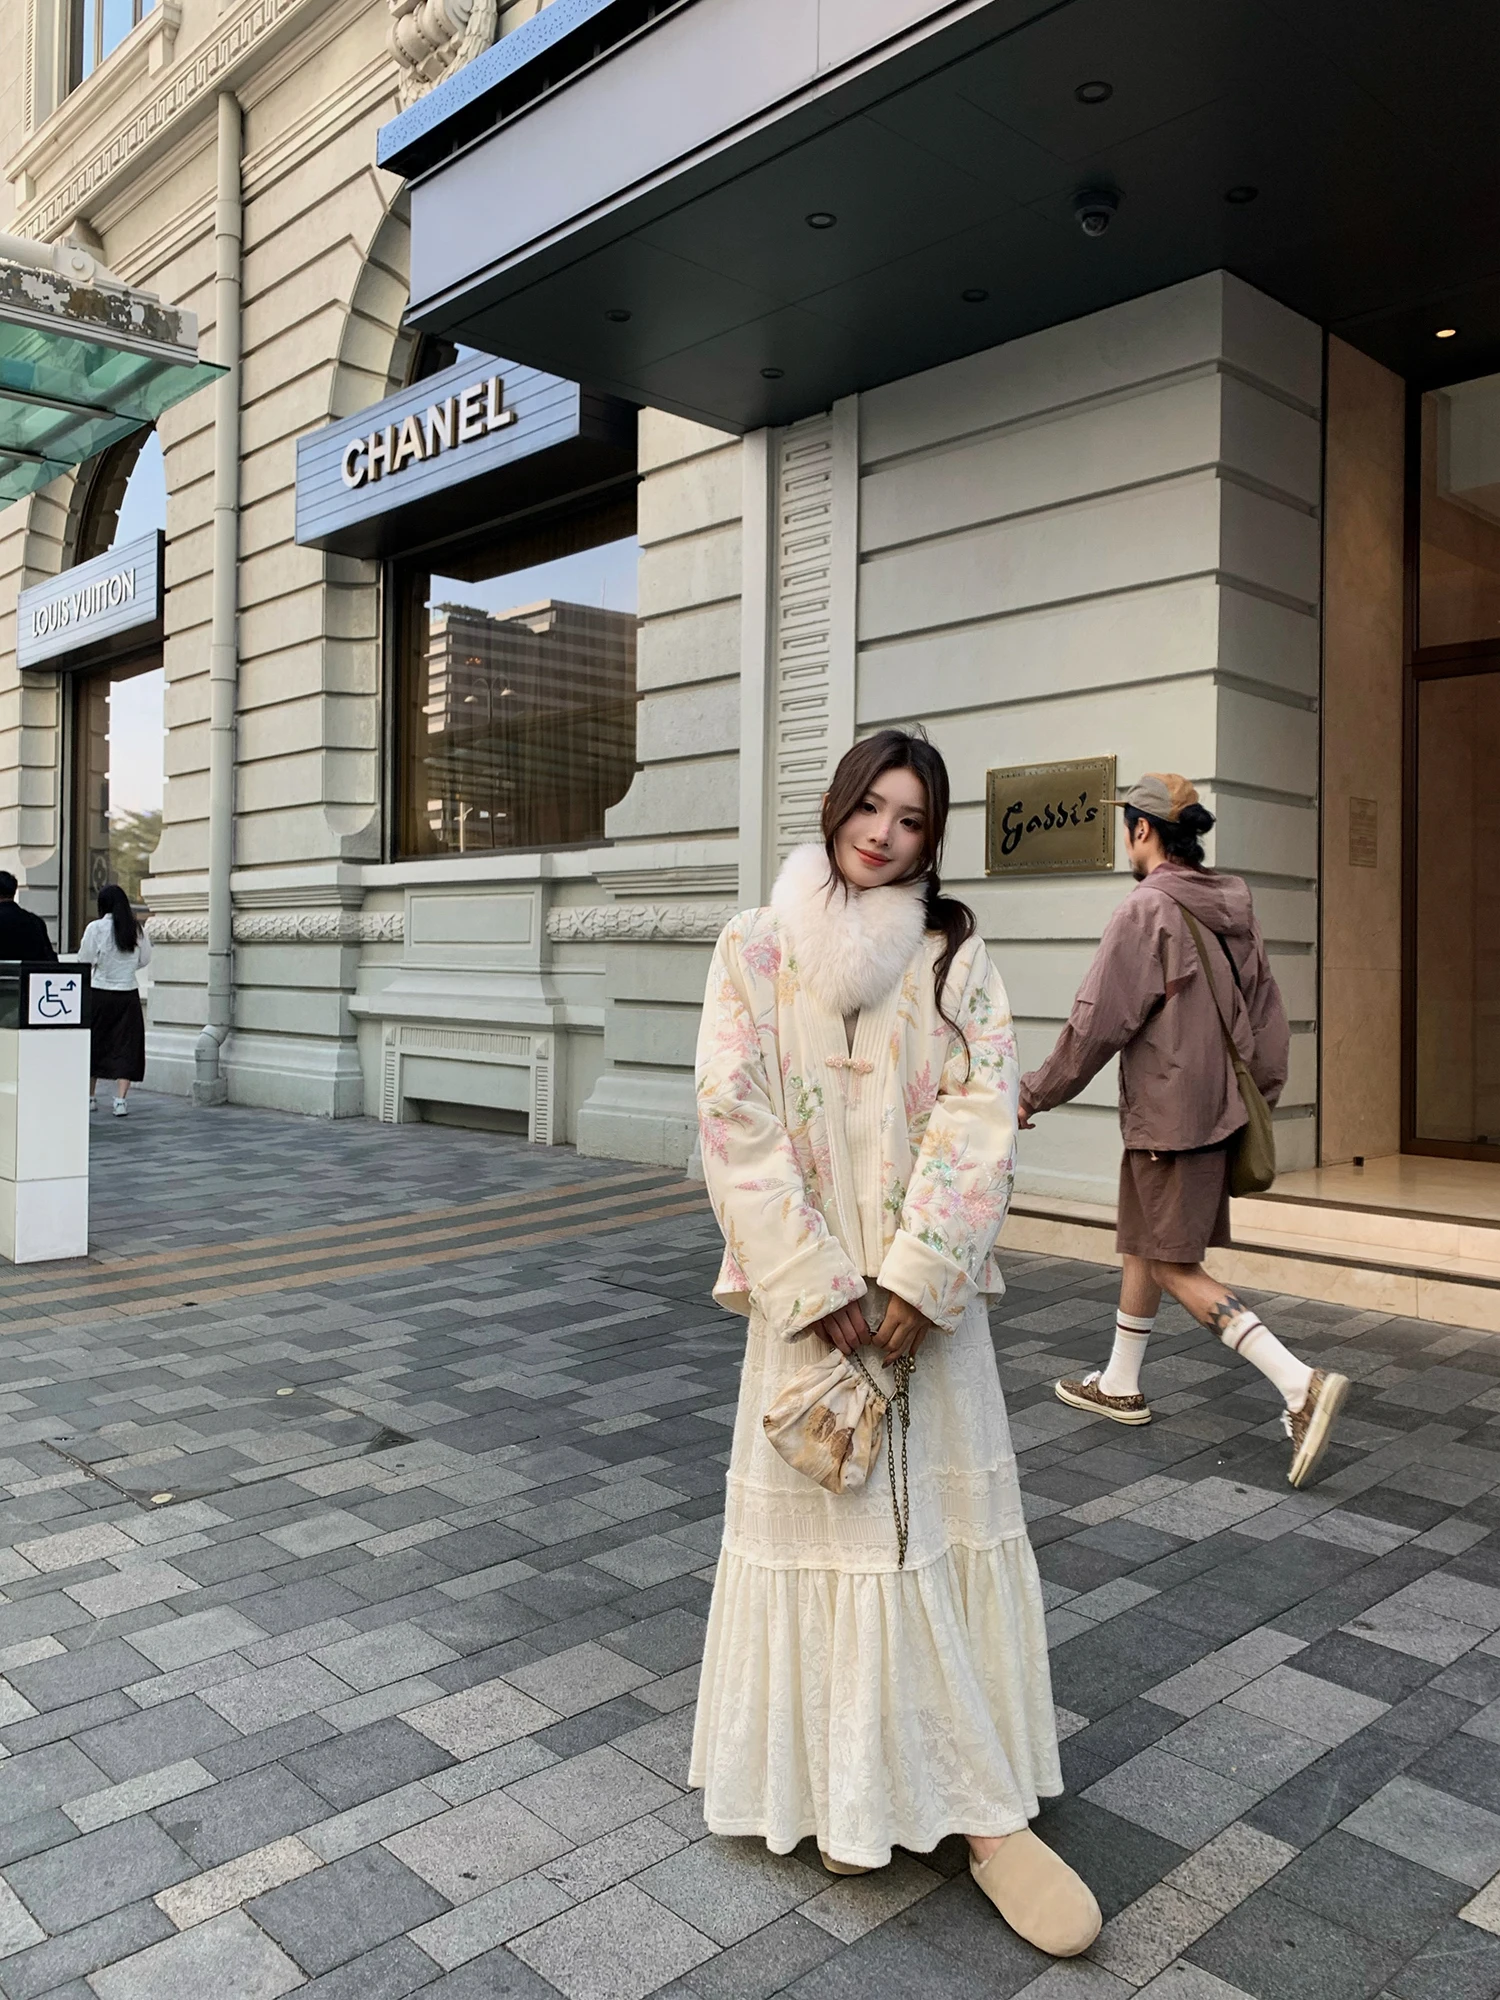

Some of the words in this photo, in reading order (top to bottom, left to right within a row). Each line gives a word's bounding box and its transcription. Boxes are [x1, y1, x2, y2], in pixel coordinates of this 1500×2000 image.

[341, 376, 516, 488] CHANEL
[32, 597, 70, 637] LOUIS
[73, 567, 136, 621] VUITTON
[1001, 791, 1098, 855] Gaddi's
